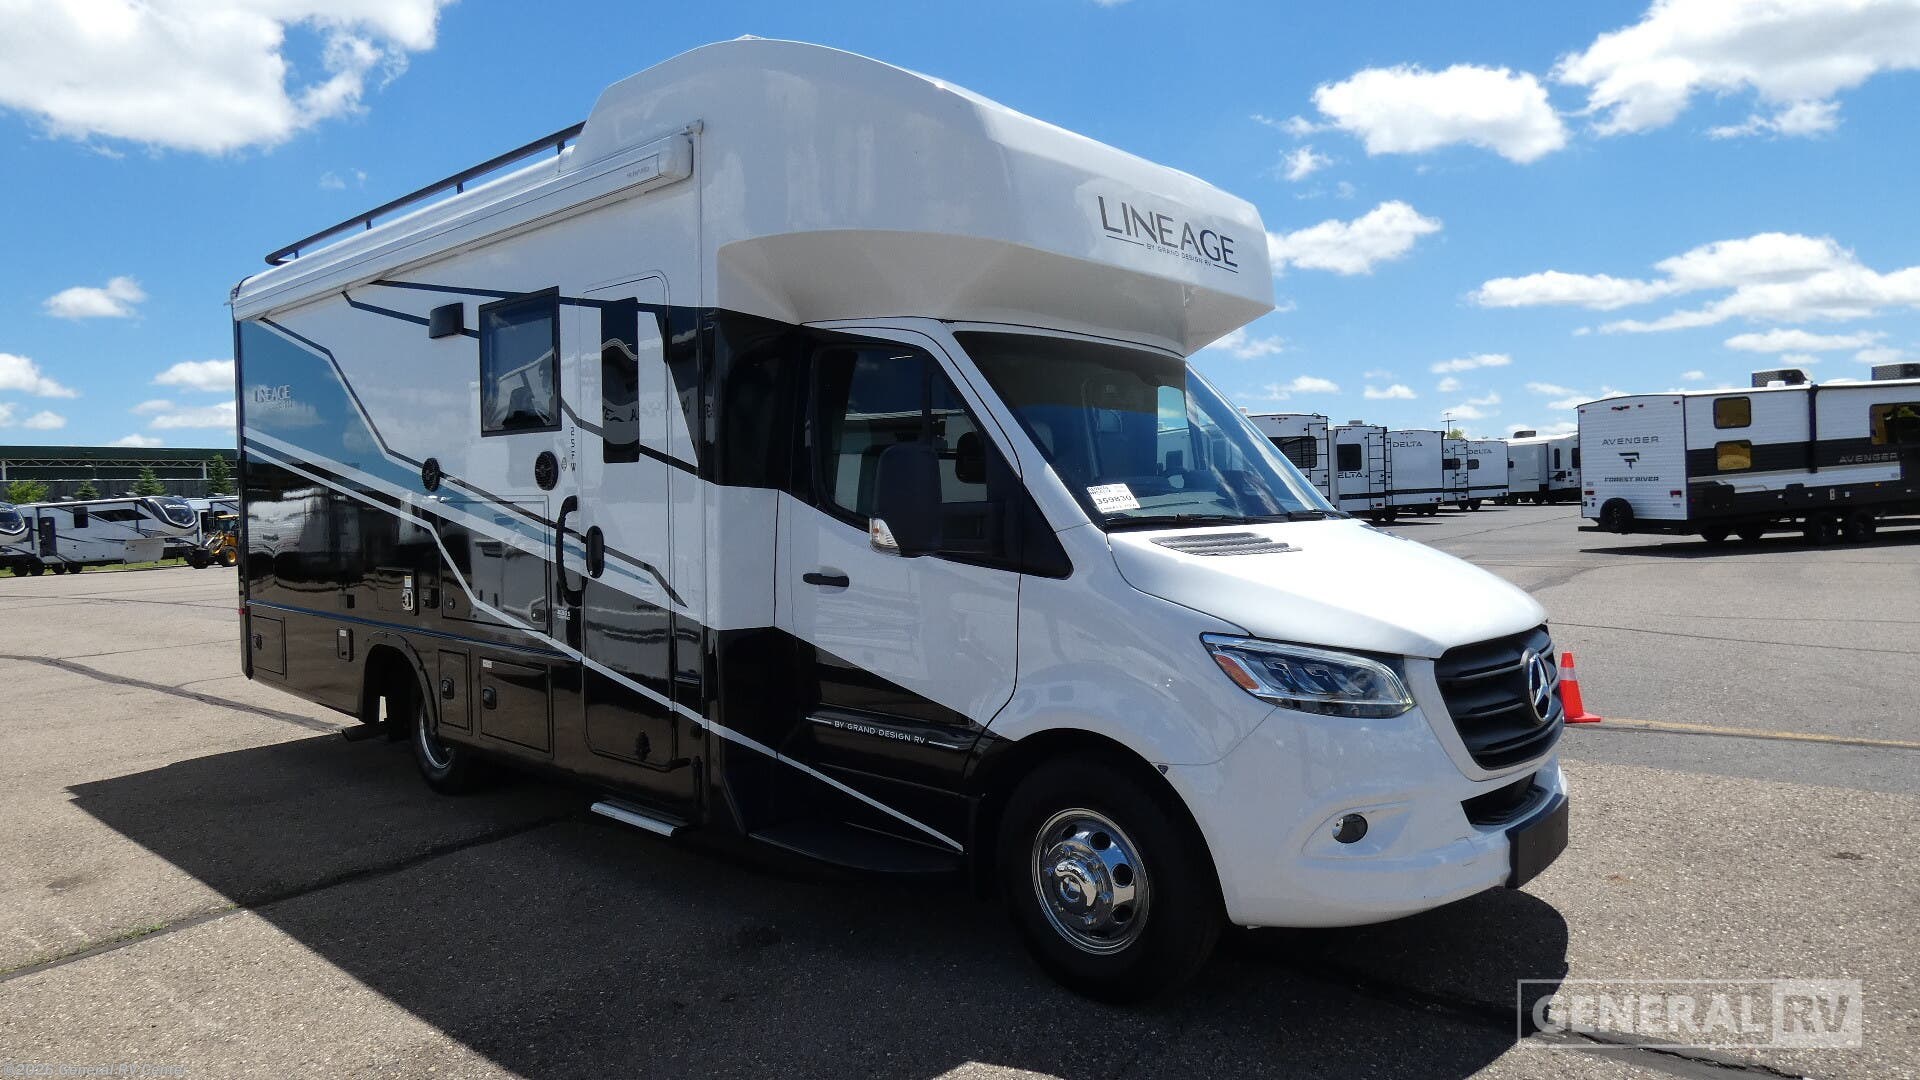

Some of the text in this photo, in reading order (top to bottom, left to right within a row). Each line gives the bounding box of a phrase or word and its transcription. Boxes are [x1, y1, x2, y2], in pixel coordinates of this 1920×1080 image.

[1097, 195, 1238, 268] LINEAGE
[1602, 436, 1659, 446] AVENGER
[1839, 452, 1898, 464] AVENGER
[1337, 471, 1363, 479] ELTA
[834, 720, 925, 744] BY GRAND DESIGN RV
